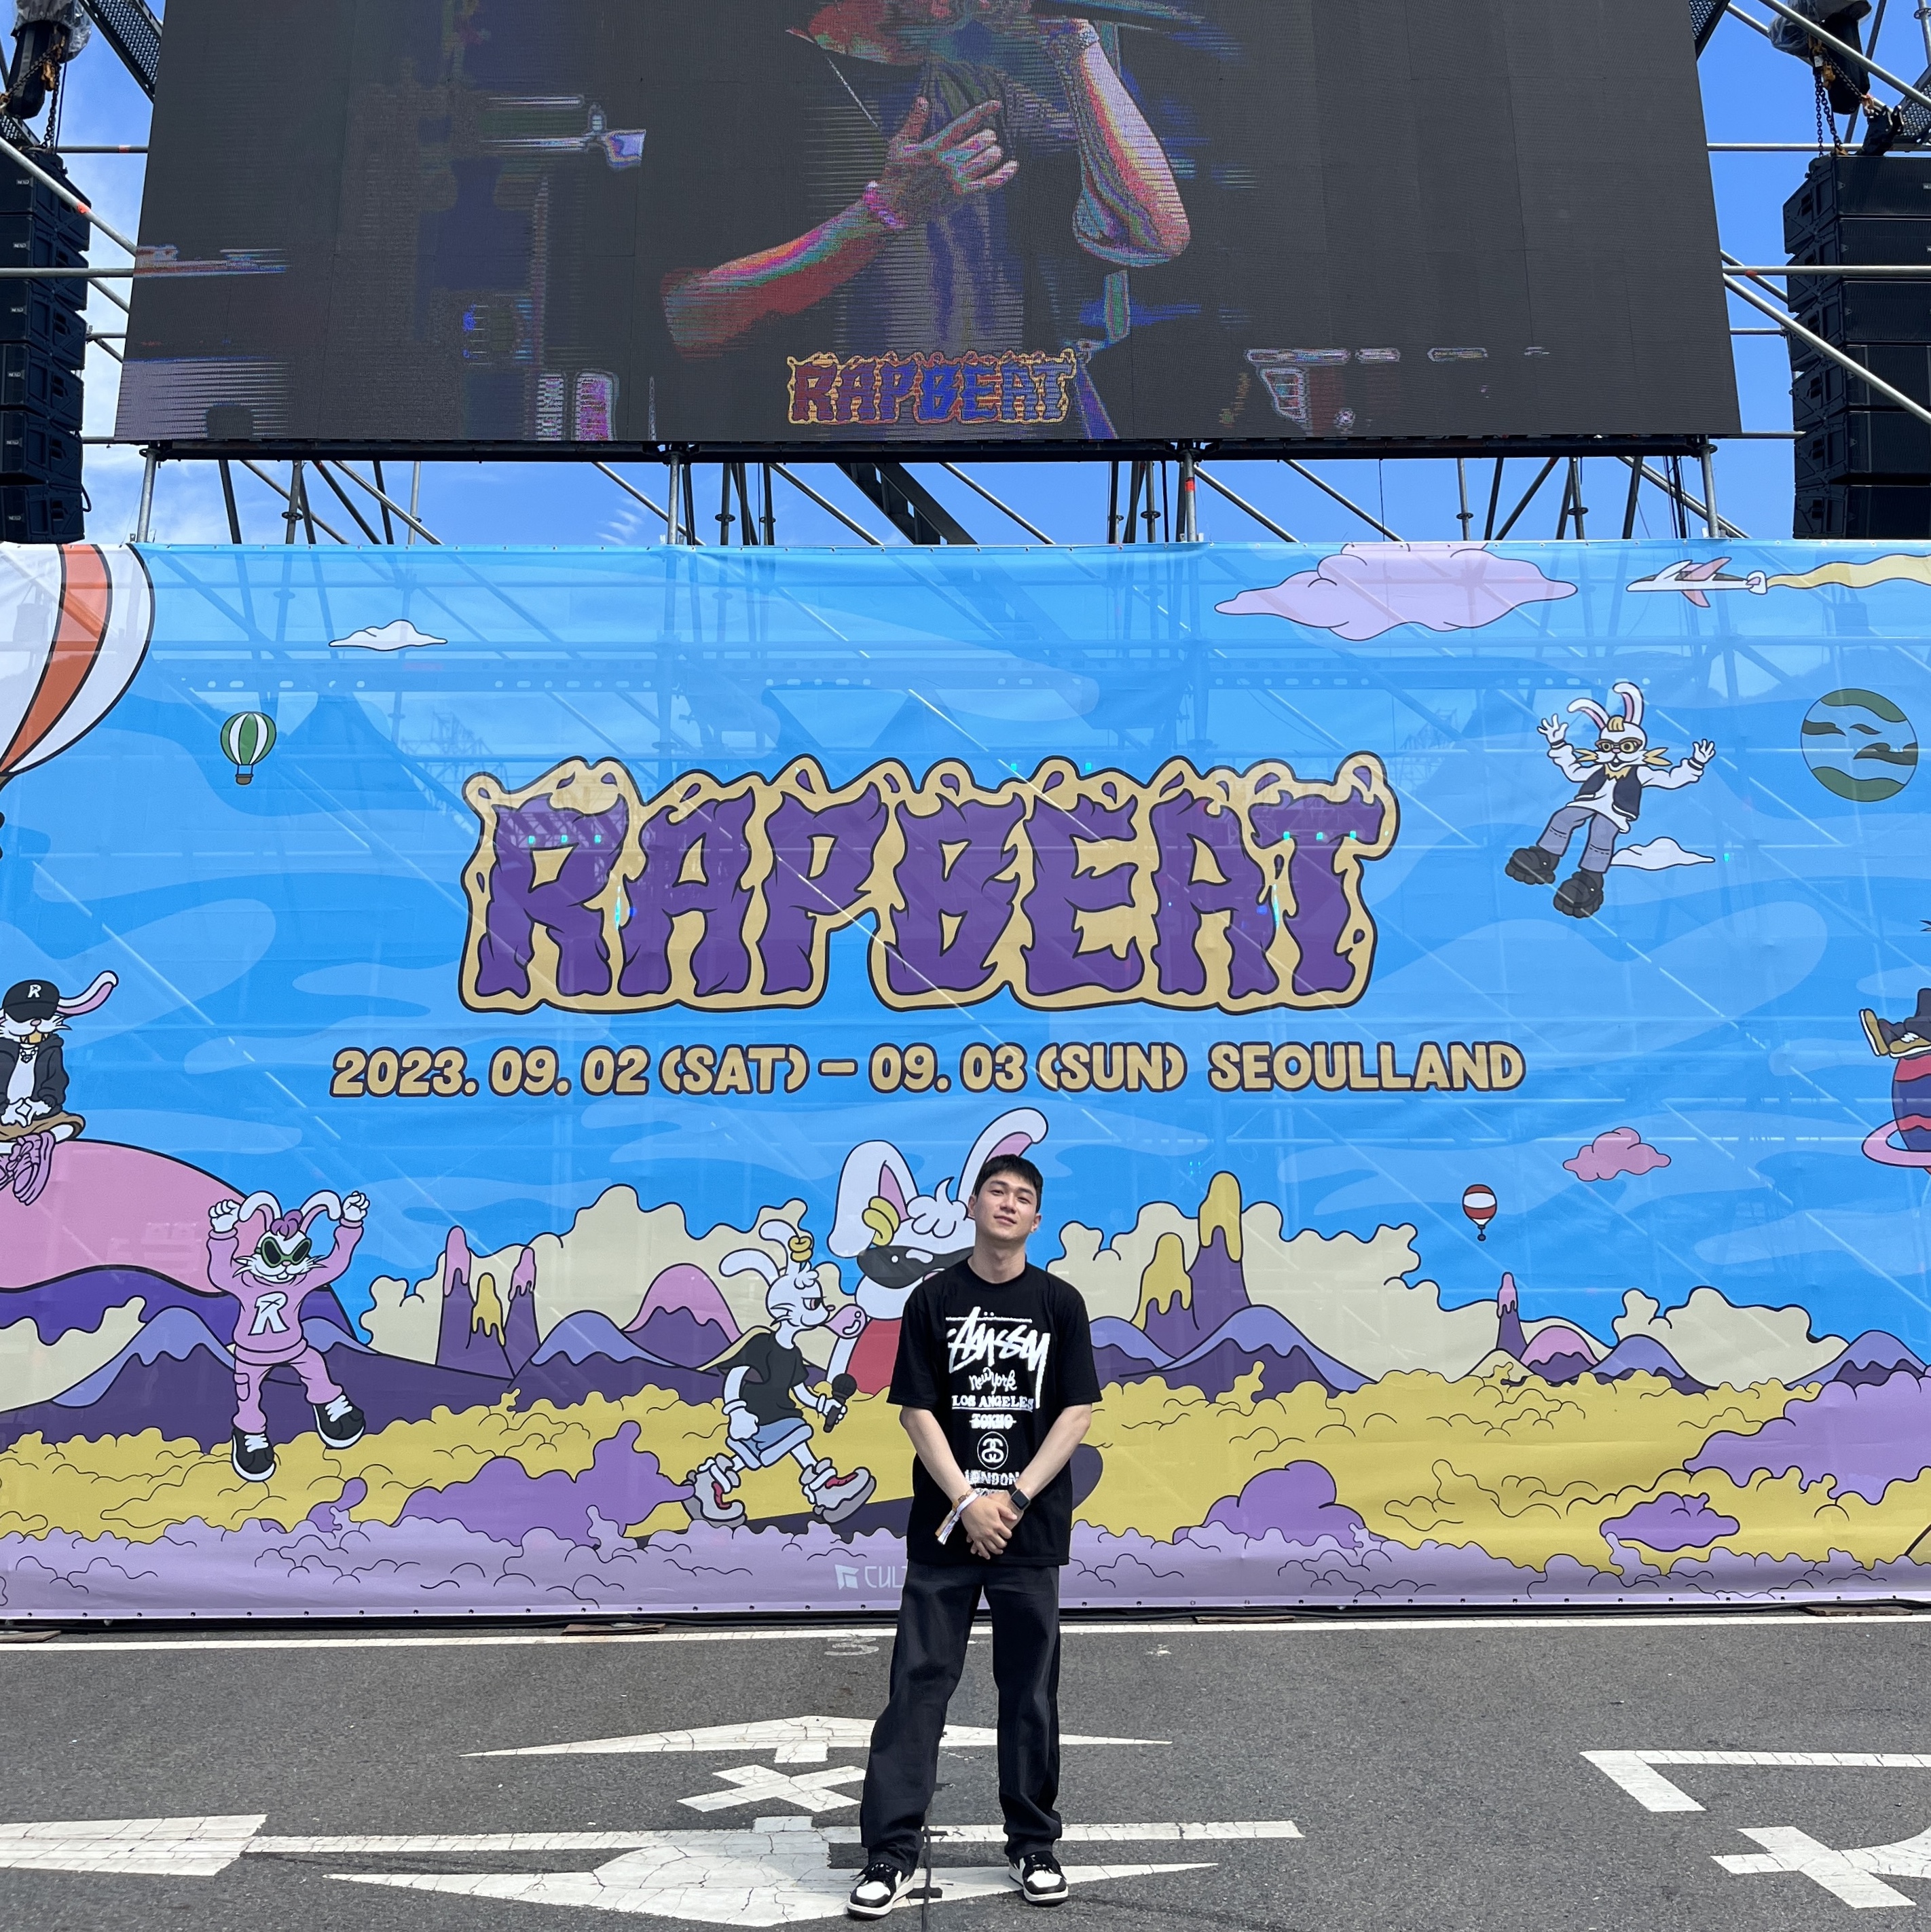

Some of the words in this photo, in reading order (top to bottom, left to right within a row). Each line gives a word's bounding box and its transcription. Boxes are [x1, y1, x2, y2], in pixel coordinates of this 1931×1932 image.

[787, 348, 1078, 424] RAPBEAT
[459, 754, 1400, 1015] RAPBEAT
[27, 984, 42, 998] R
[330, 1046, 479, 1097] 2023.
[488, 1045, 572, 1096] 09.
[581, 1044, 650, 1095] 02
[659, 1044, 811, 1095] (SAT)
[868, 1042, 951, 1093] 09.
[959, 1042, 1028, 1093] 03
[1037, 1041, 1188, 1093] (SUN)
[1208, 1041, 1526, 1092] SEOULLAND
[248, 1291, 291, 1336] R
[951, 1395, 976, 1408] LOS
[978, 1395, 1034, 1410] ANGELES
[965, 1469, 1020, 1486] LONDON
[864, 1565, 908, 1588] CUL
